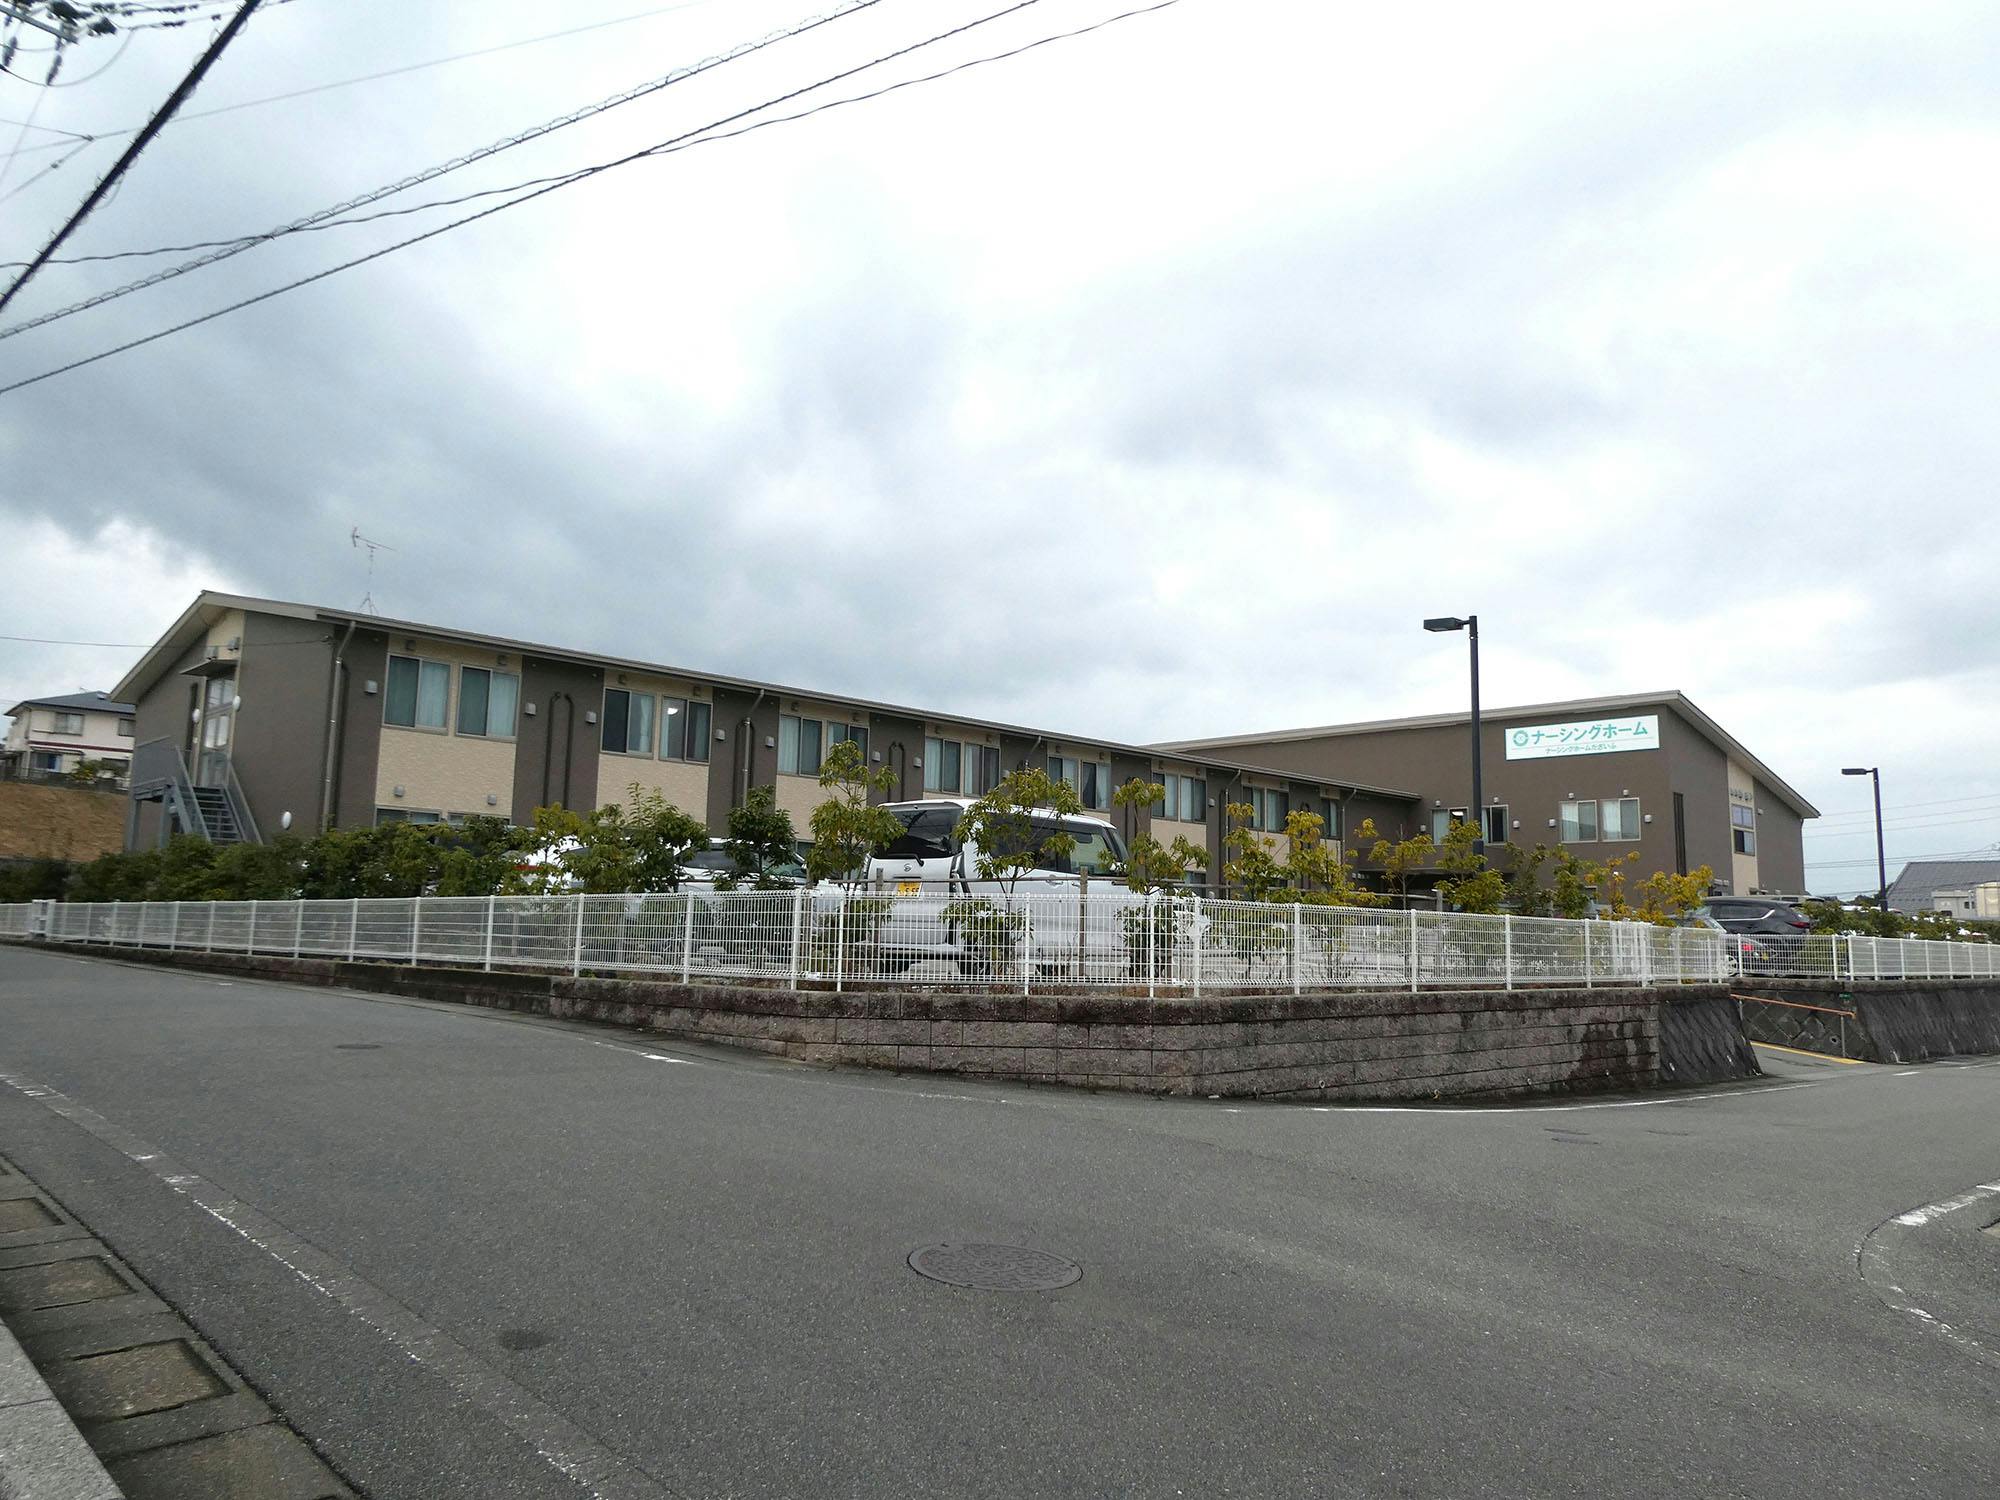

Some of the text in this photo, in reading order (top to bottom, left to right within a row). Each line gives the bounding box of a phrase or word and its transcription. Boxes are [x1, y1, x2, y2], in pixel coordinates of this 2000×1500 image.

[1531, 721, 1648, 745] ナーシングホーム
